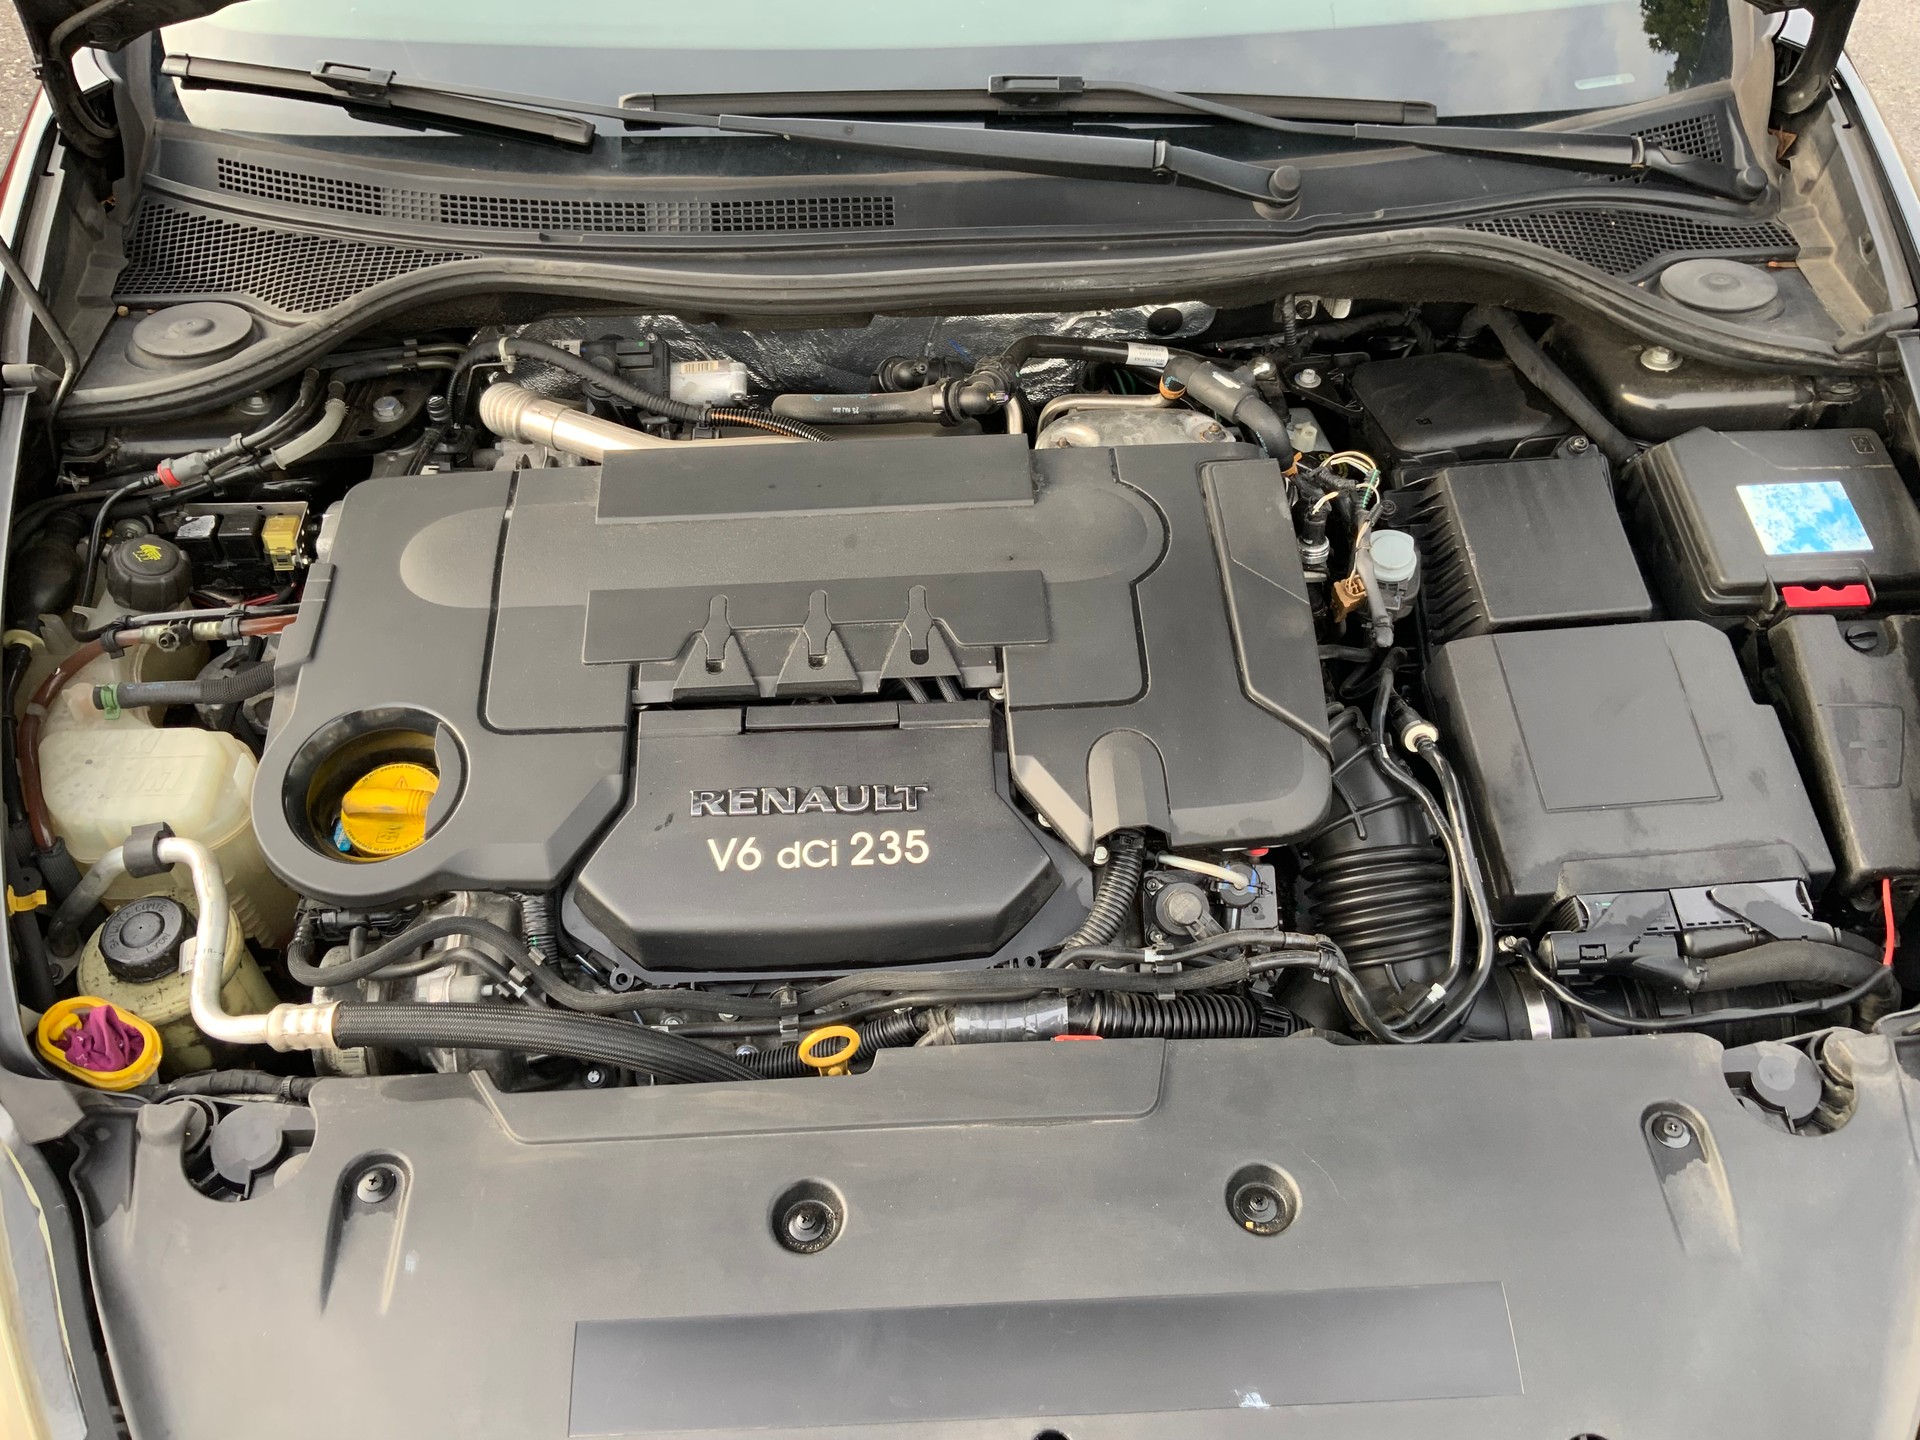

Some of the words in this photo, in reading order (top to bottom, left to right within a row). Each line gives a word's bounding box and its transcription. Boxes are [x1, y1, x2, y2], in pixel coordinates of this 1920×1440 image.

[690, 784, 929, 817] RENAULT
[707, 836, 762, 872] V6
[777, 839, 838, 869] dCi
[850, 829, 930, 865] 235
[146, 932, 171, 953] LYON
